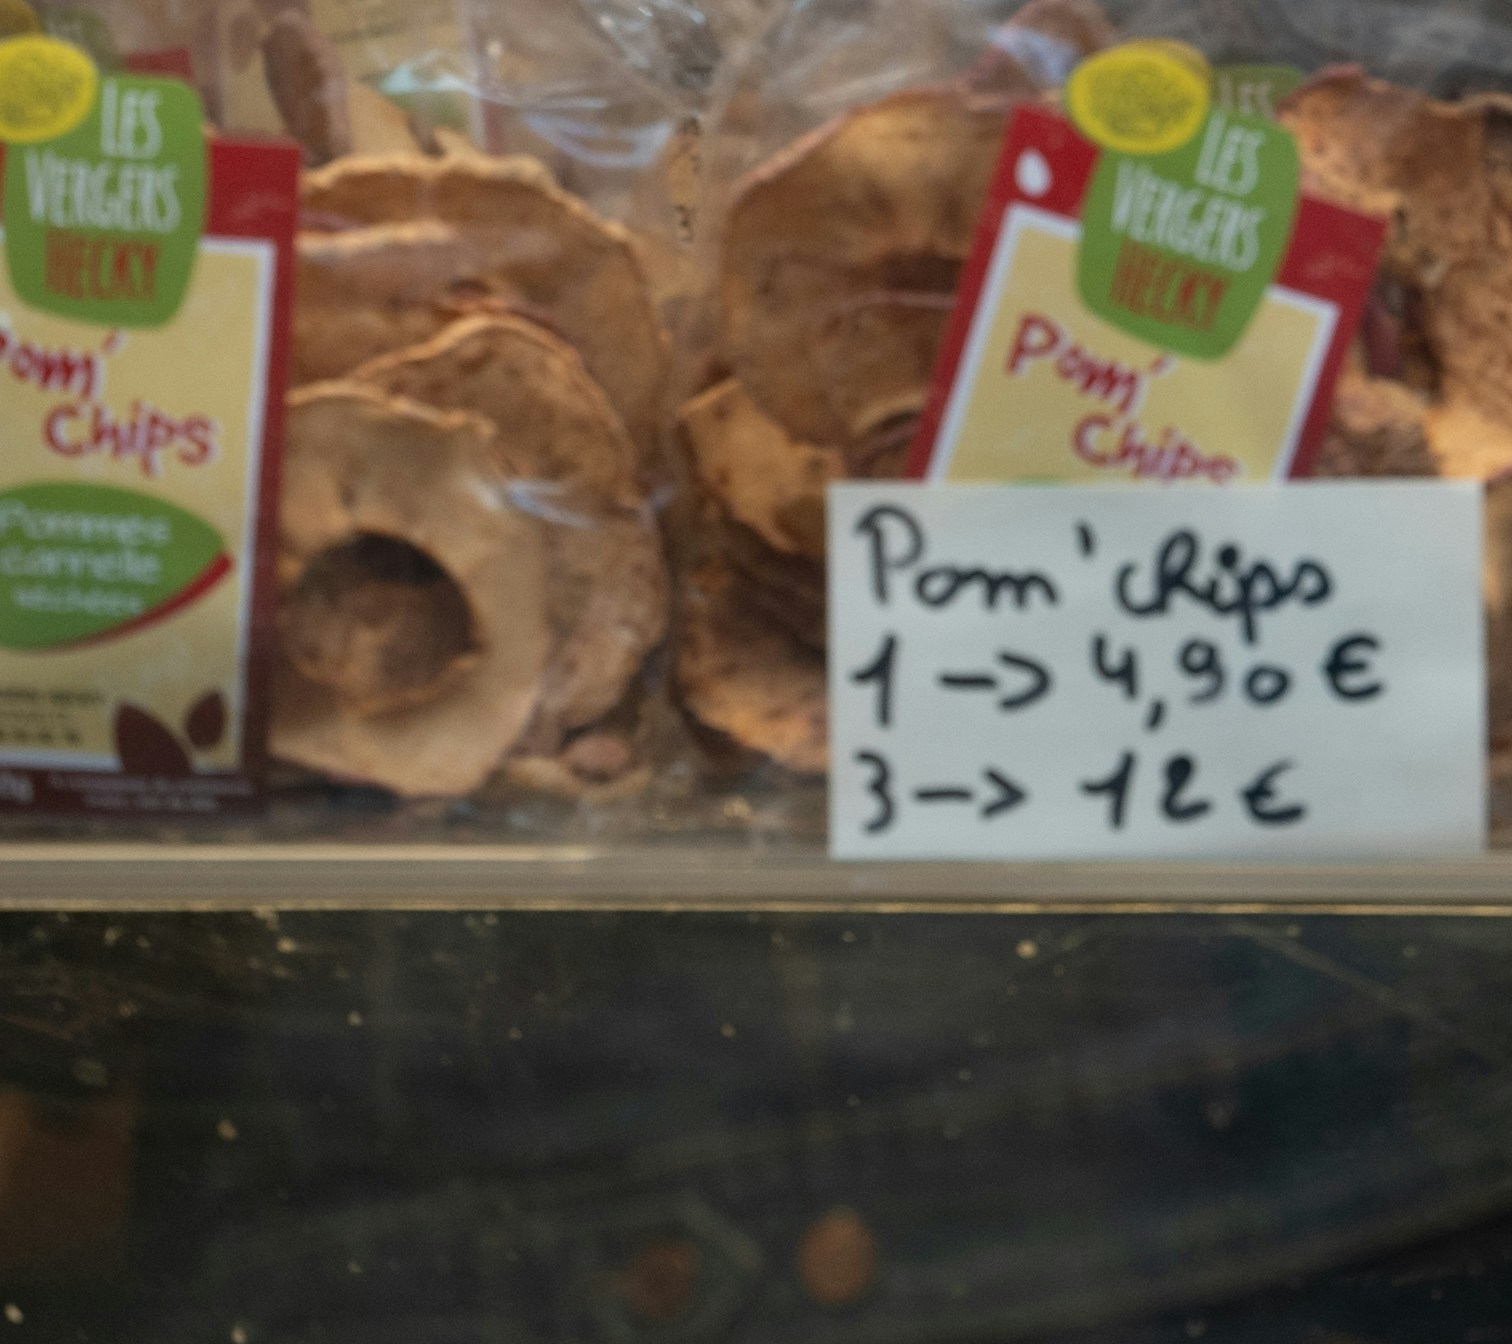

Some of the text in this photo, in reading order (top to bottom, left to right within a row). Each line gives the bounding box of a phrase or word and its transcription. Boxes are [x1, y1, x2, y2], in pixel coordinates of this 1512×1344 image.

[99, 78, 165, 159] LES
[1193, 112, 1268, 198] LES
[22, 151, 183, 237] VERGERS
[1108, 159, 1270, 276] VERGERS
[41, 405, 218, 483] Chips
[849, 632, 901, 729] 1
[852, 751, 896, 836] 3
